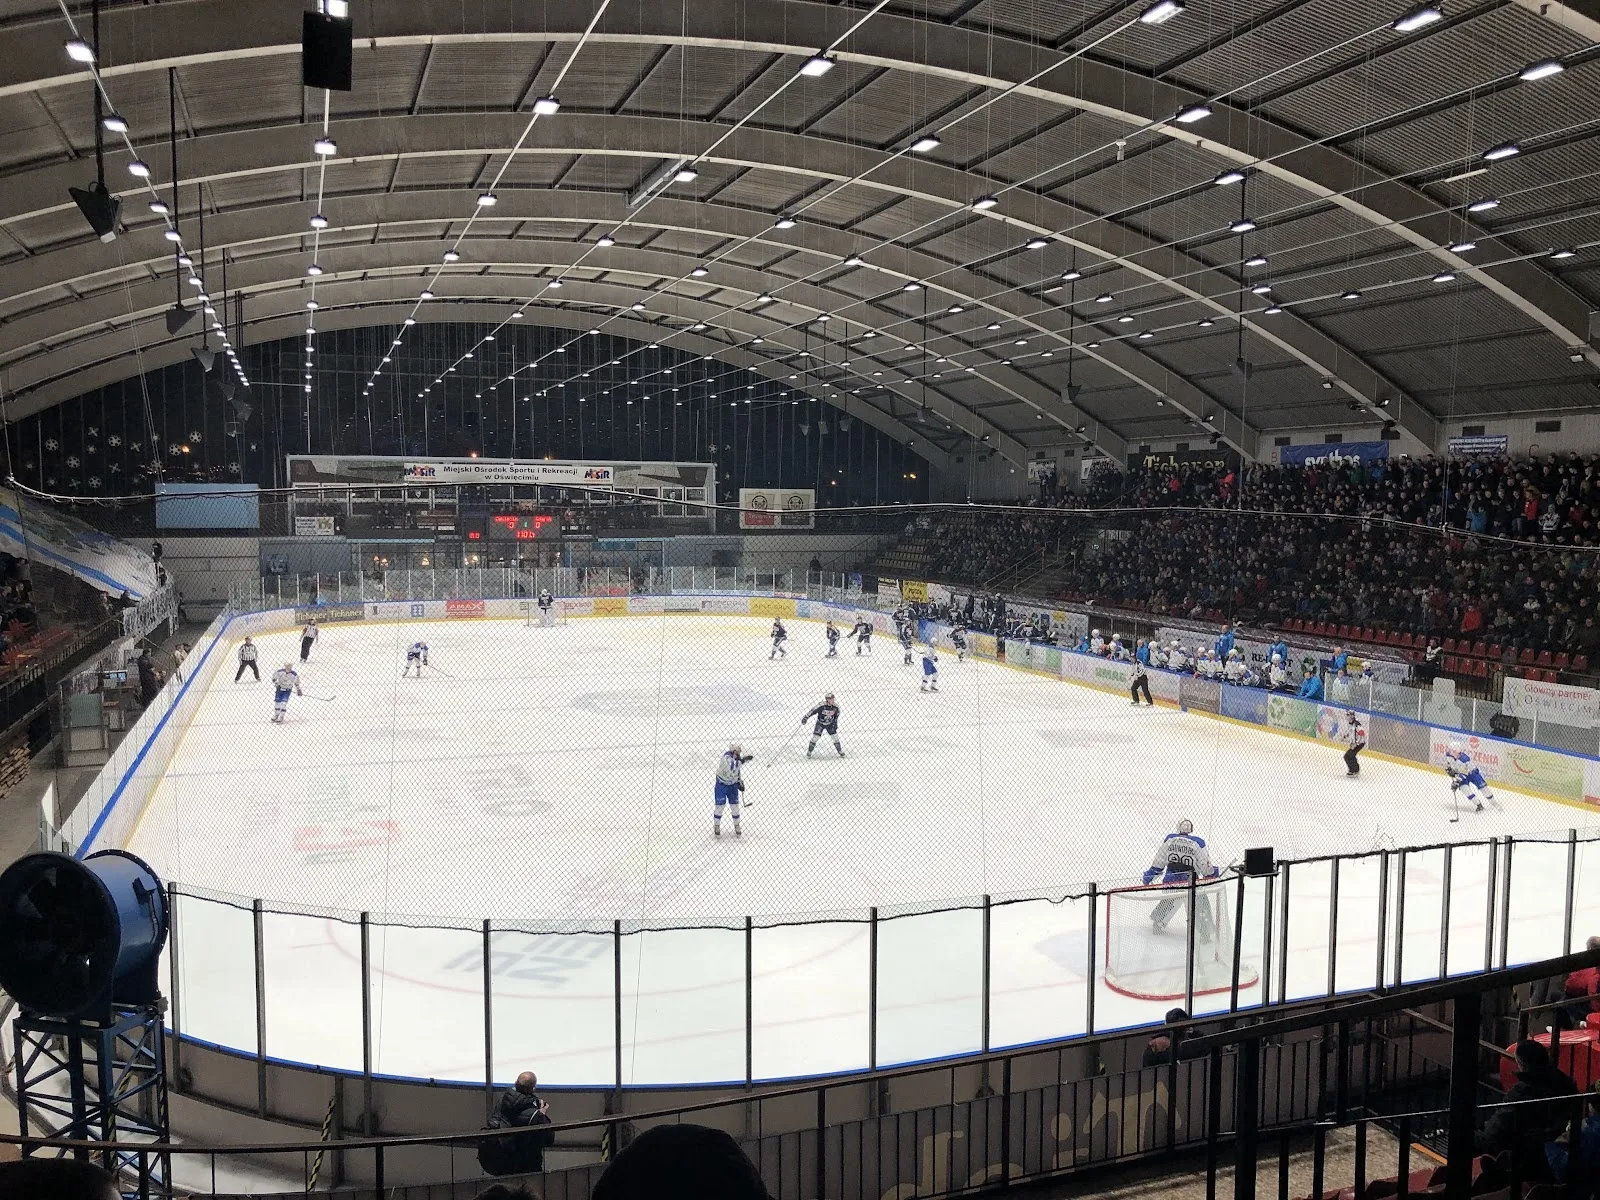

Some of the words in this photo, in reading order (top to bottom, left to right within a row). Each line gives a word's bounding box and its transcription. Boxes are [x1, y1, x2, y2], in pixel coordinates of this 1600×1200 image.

[443, 466, 472, 474] Miejski
[474, 465, 507, 473] Ośrodek
[510, 467, 535, 475] Sportu
[542, 467, 578, 475] Rekreacji
[1558, 689, 1593, 701] partner
